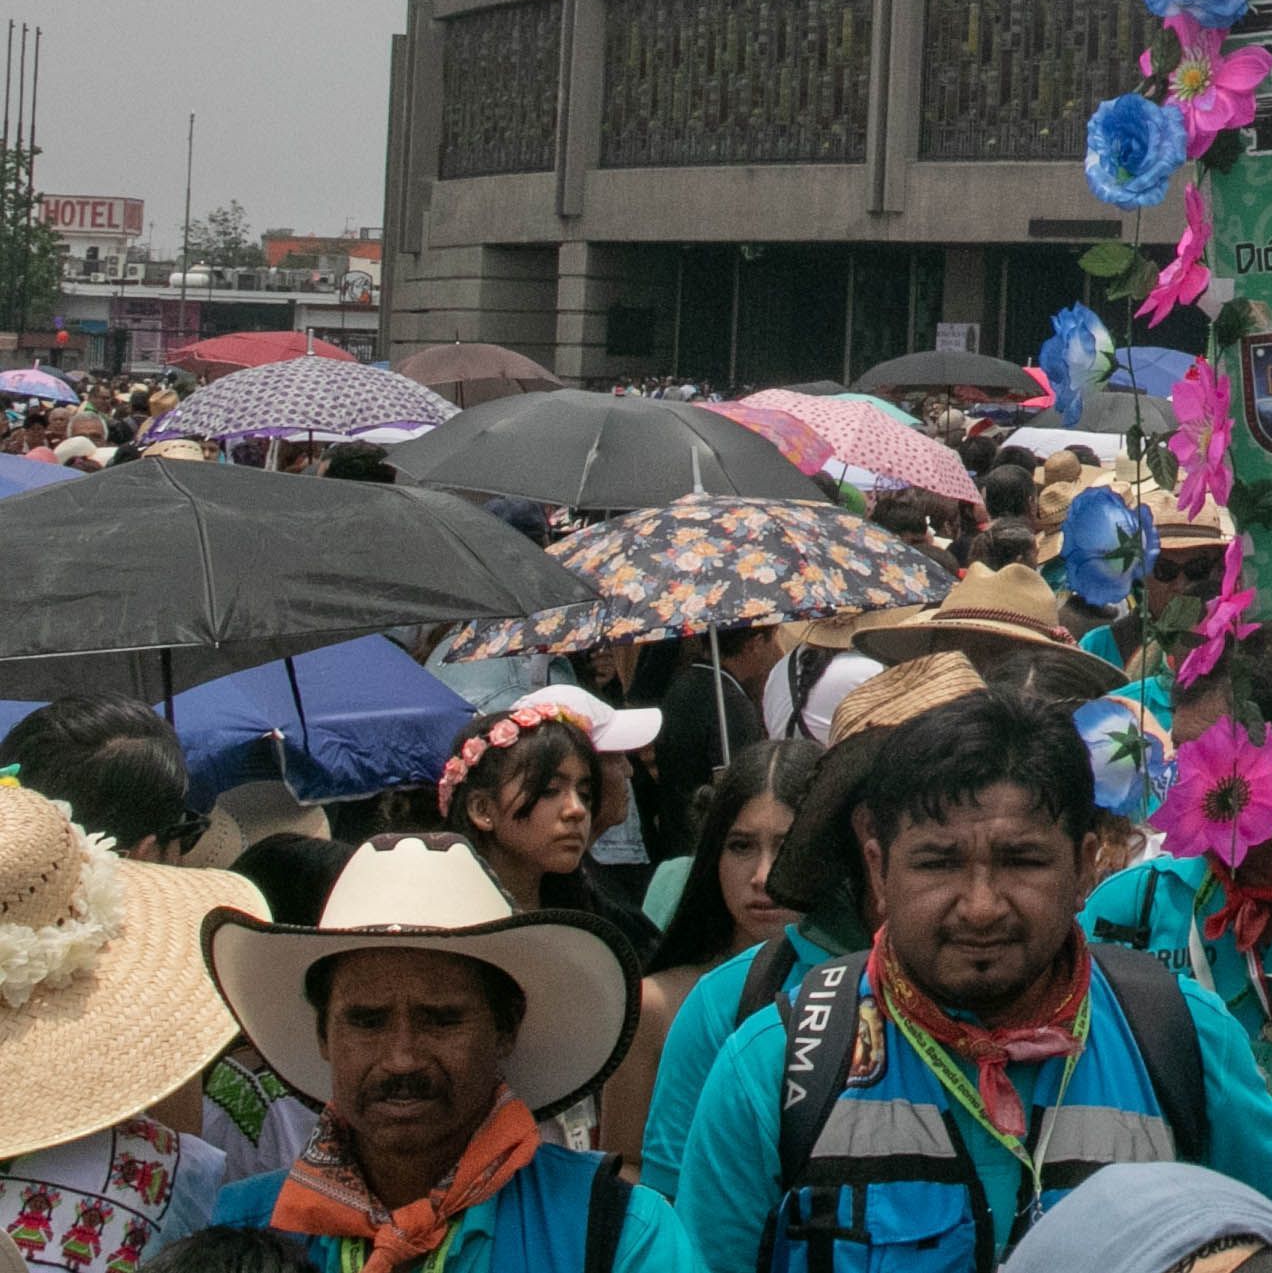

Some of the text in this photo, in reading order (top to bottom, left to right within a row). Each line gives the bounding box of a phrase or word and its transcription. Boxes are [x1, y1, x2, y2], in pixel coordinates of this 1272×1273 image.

[44, 199, 120, 228] HOTEL
[783, 965, 848, 1111] PIRMA
[925, 1045, 959, 1086] Sagrada
[957, 1082, 980, 1108] como
